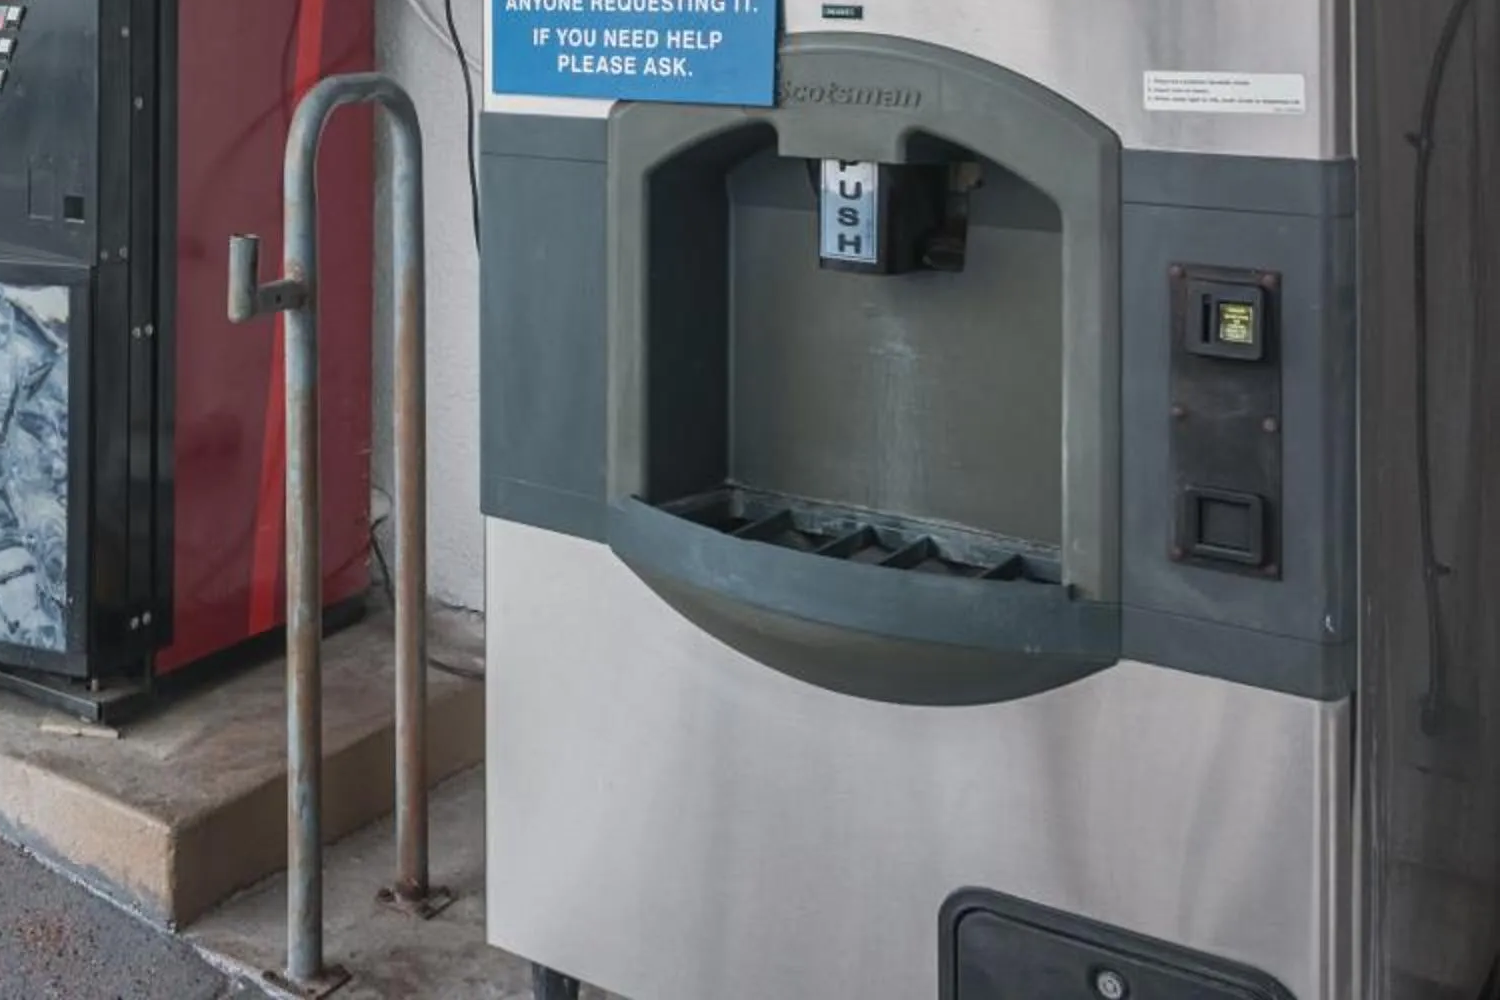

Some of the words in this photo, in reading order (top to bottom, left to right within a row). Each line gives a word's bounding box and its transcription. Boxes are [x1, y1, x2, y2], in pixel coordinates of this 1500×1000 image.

[532, 28, 550, 46] IF
[556, 28, 596, 47] YOU
[603, 30, 659, 49] NEED
[667, 30, 723, 50] HELP
[557, 55, 637, 75] PLEASE
[643, 57, 693, 77] ASK.
